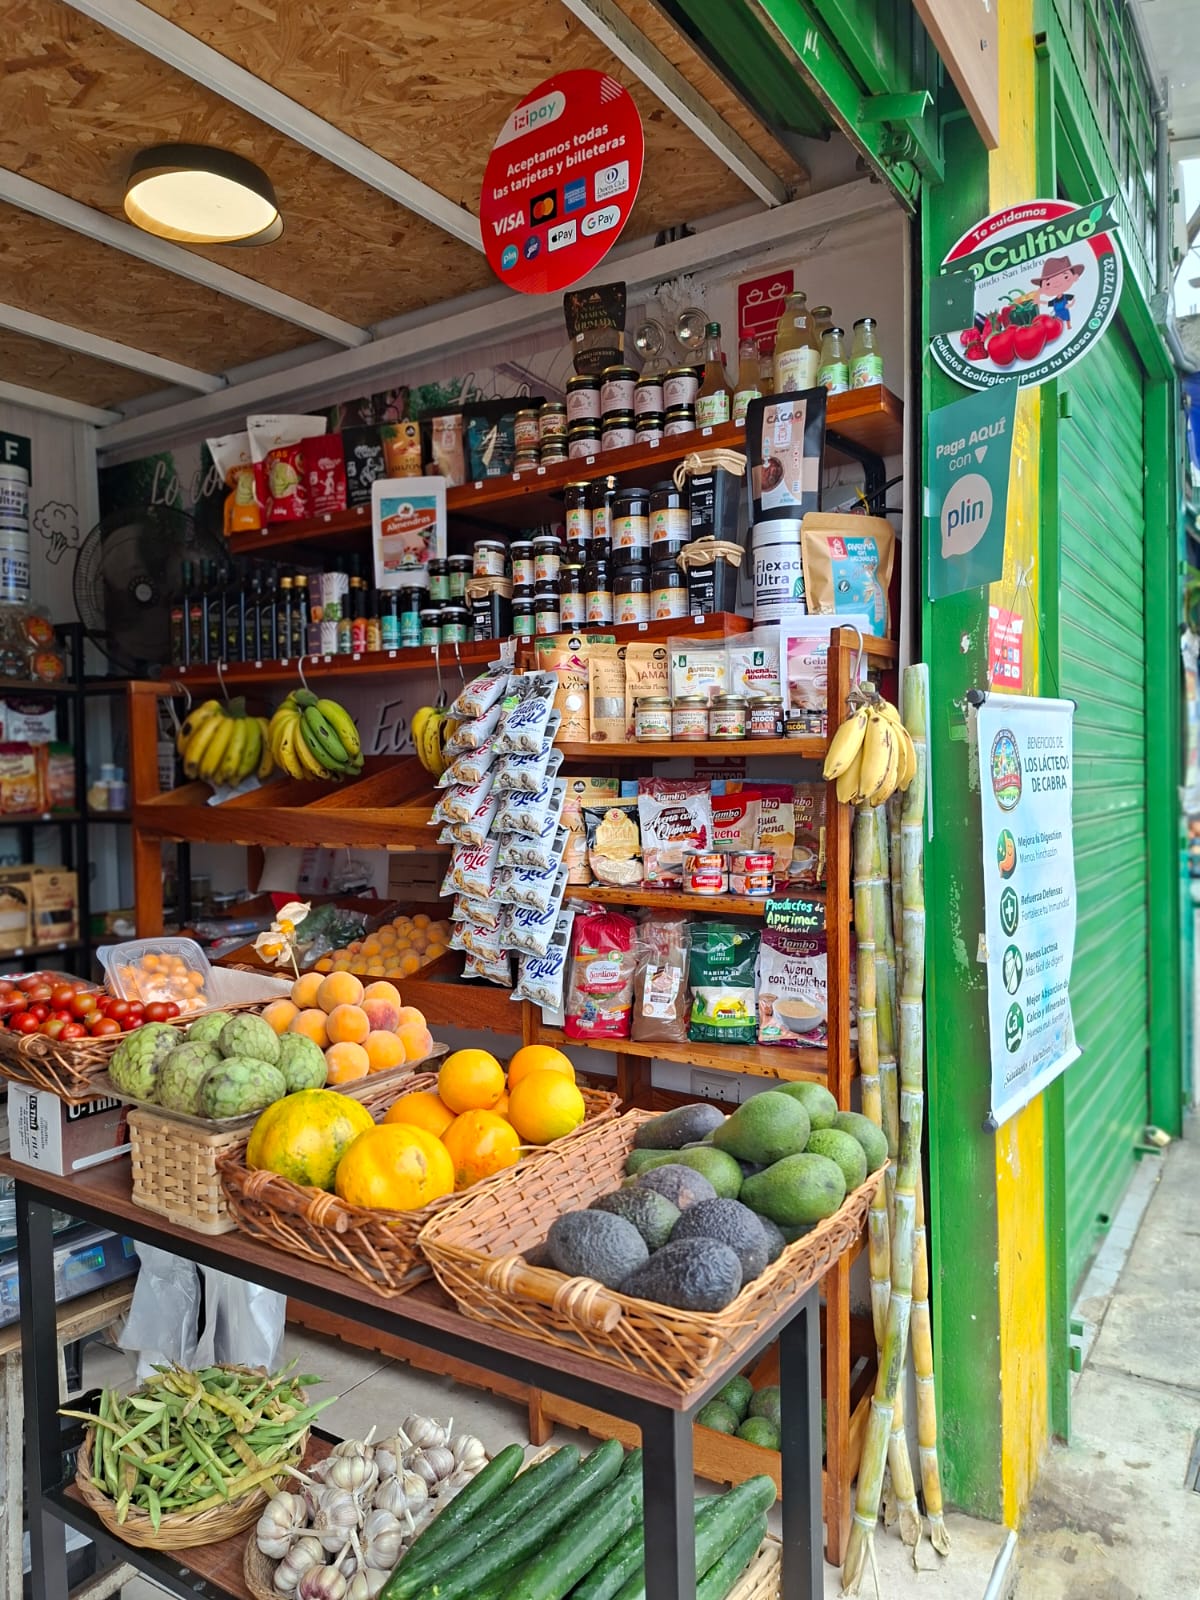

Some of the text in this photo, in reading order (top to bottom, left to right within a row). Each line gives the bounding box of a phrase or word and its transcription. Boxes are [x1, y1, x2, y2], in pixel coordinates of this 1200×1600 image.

[513, 101, 556, 132] izipay
[506, 123, 609, 177] Aceptamos todas
[493, 134, 626, 200] las tarjetas y billeteras
[491, 210, 526, 237] VISA
[597, 213, 615, 227] Pay
[973, 207, 1048, 242] Te cuidamos
[558, 228, 574, 241] Pay
[974, 258, 1046, 292] undo San Isidro
[1094, 256, 1115, 319] 950 172732
[934, 332, 1092, 387] roductos Ecológic para tu Mesa
[766, 409, 803, 425] CACAO
[936, 416, 1006, 460] Paga AQUÍ
[949, 453, 972, 471] con
[387, 516, 431, 533] Almendras
[947, 498, 984, 537] plin
[756, 559, 804, 573] Flexaci
[756, 573, 789, 587] Ultra
[803, 656, 826, 666] Gela
[637, 671, 668, 682] JAMAI
[745, 667, 769, 675] Avena
[507, 708, 547, 729] azul
[1027, 736, 1064, 749] BENEFICIOS DE
[1024, 753, 1070, 773] LOS LÁCTEOS
[1031, 775, 1068, 792] DE CABRA
[655, 792, 686, 800] Tambo
[644, 811, 679, 831] Avena
[714, 830, 740, 839] vena
[1018, 836, 1035, 848] Mejora
[455, 850, 490, 871] roja
[1043, 887, 1063, 899] Defensas
[766, 899, 824, 913] Productos de
[515, 905, 554, 926] azul
[766, 911, 819, 927] Apurimac
[776, 923, 811, 934] Artesanal
[781, 938, 816, 949] Tambo
[1025, 943, 1058, 962] Menos Lactosa
[526, 956, 563, 978] azul
[784, 964, 813, 975] Avena
[768, 975, 827, 988] con Kiwicha
[1026, 993, 1041, 1007] Mejor
[1026, 1010, 1041, 1023] Calcio
[1045, 997, 1066, 1014] Minerales
[31, 1135, 39, 1160] FILM
